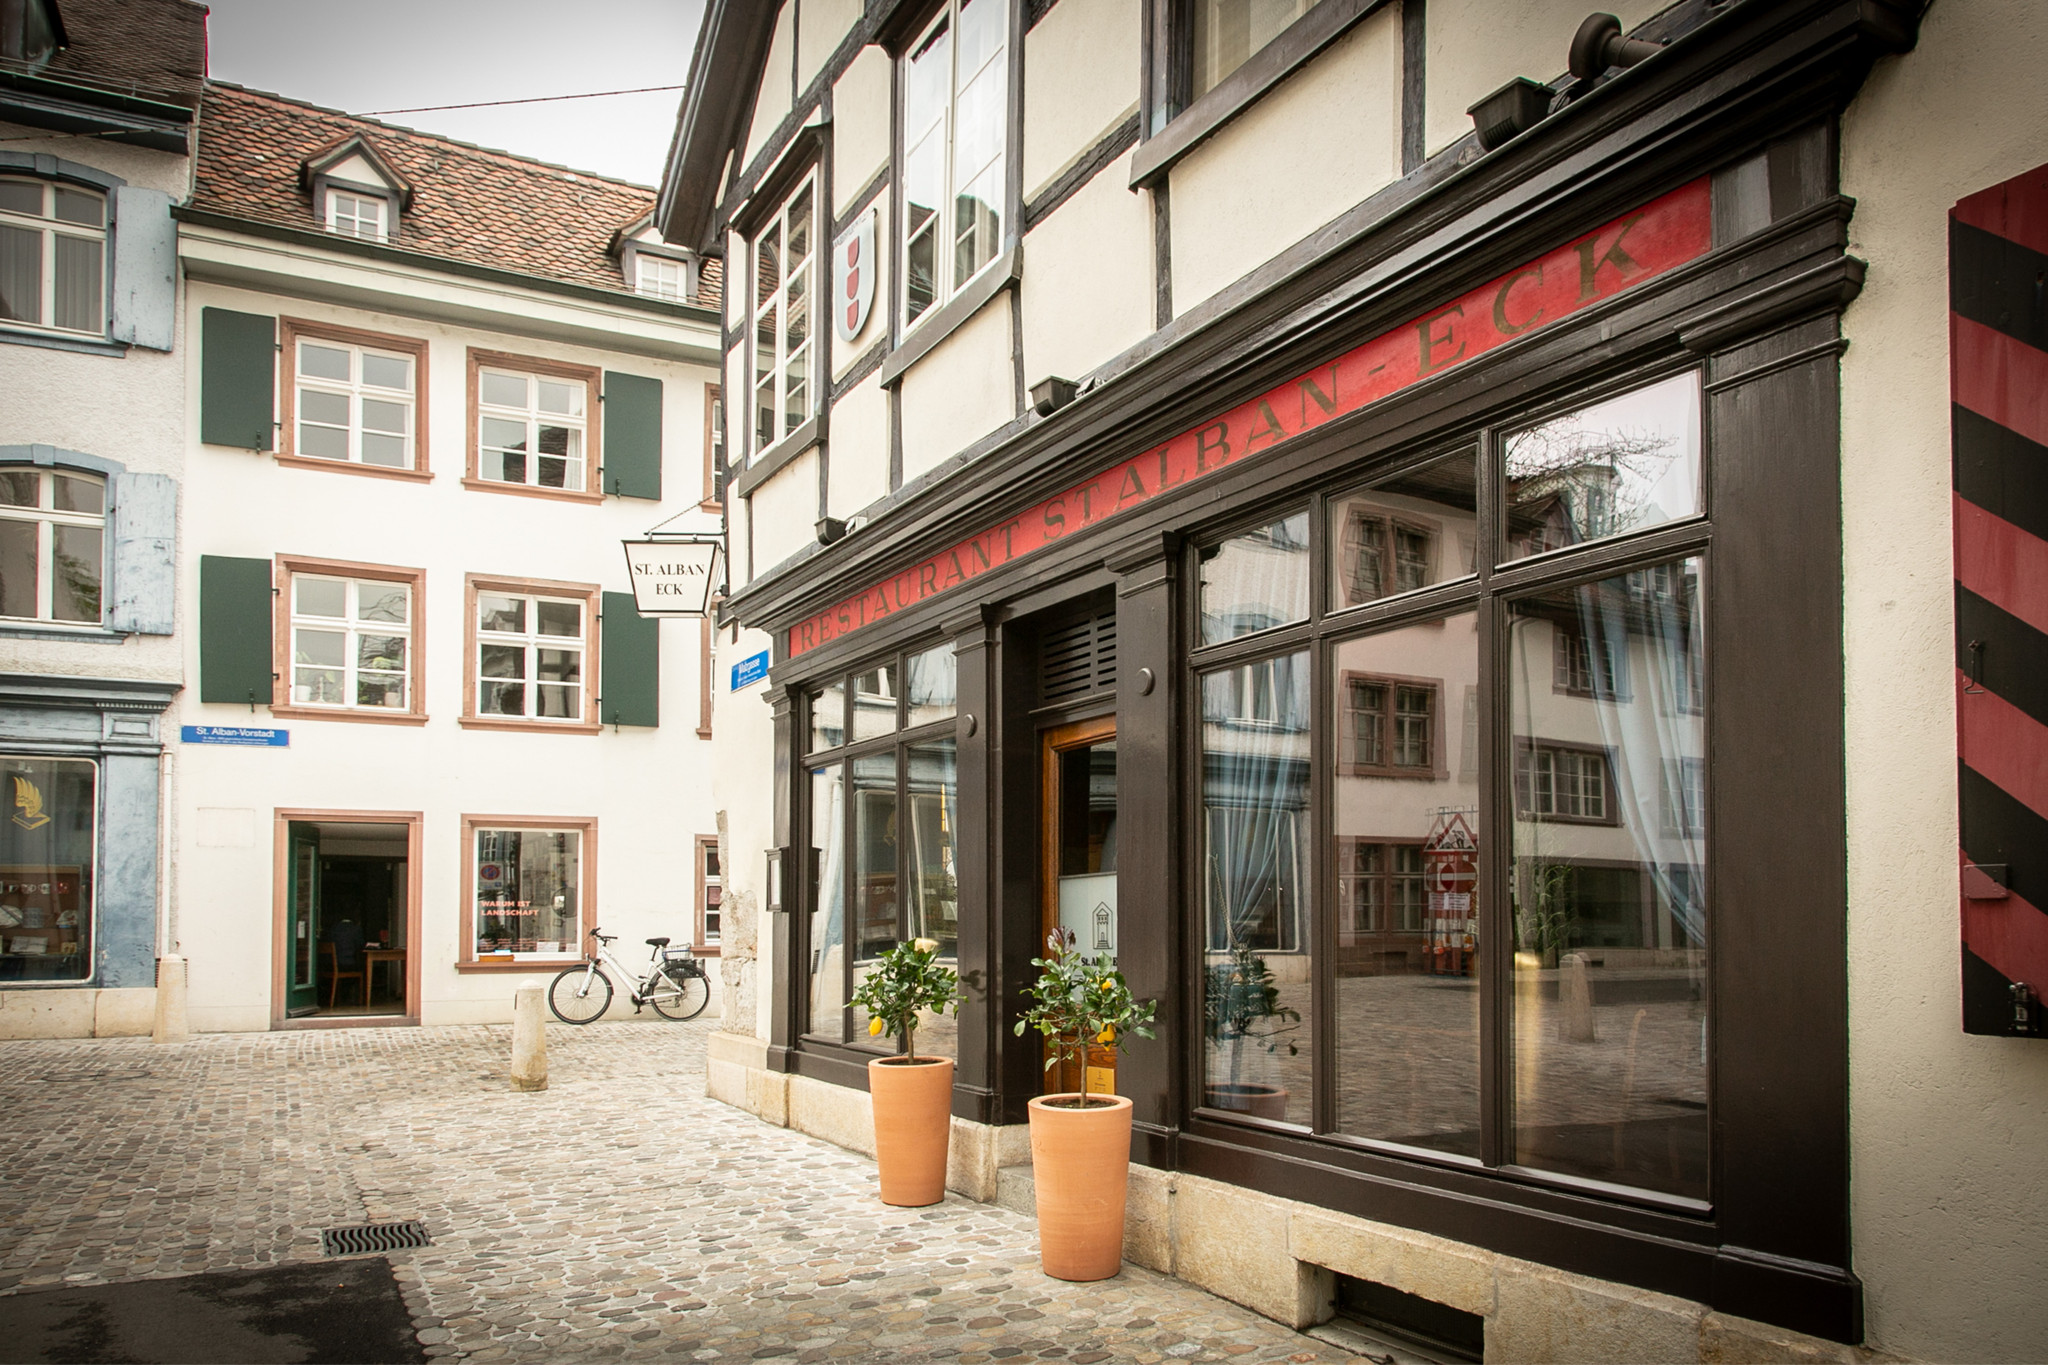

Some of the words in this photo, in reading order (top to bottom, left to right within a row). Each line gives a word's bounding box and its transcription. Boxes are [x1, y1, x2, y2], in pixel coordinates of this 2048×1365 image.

[635, 563, 653, 575] ST.
[656, 563, 705, 576] ALBAN
[656, 583, 683, 596] ECK
[799, 521, 1020, 651] RESTAURANT
[196, 726, 209, 735] St.
[211, 727, 275, 738] Alban-Vorstadt
